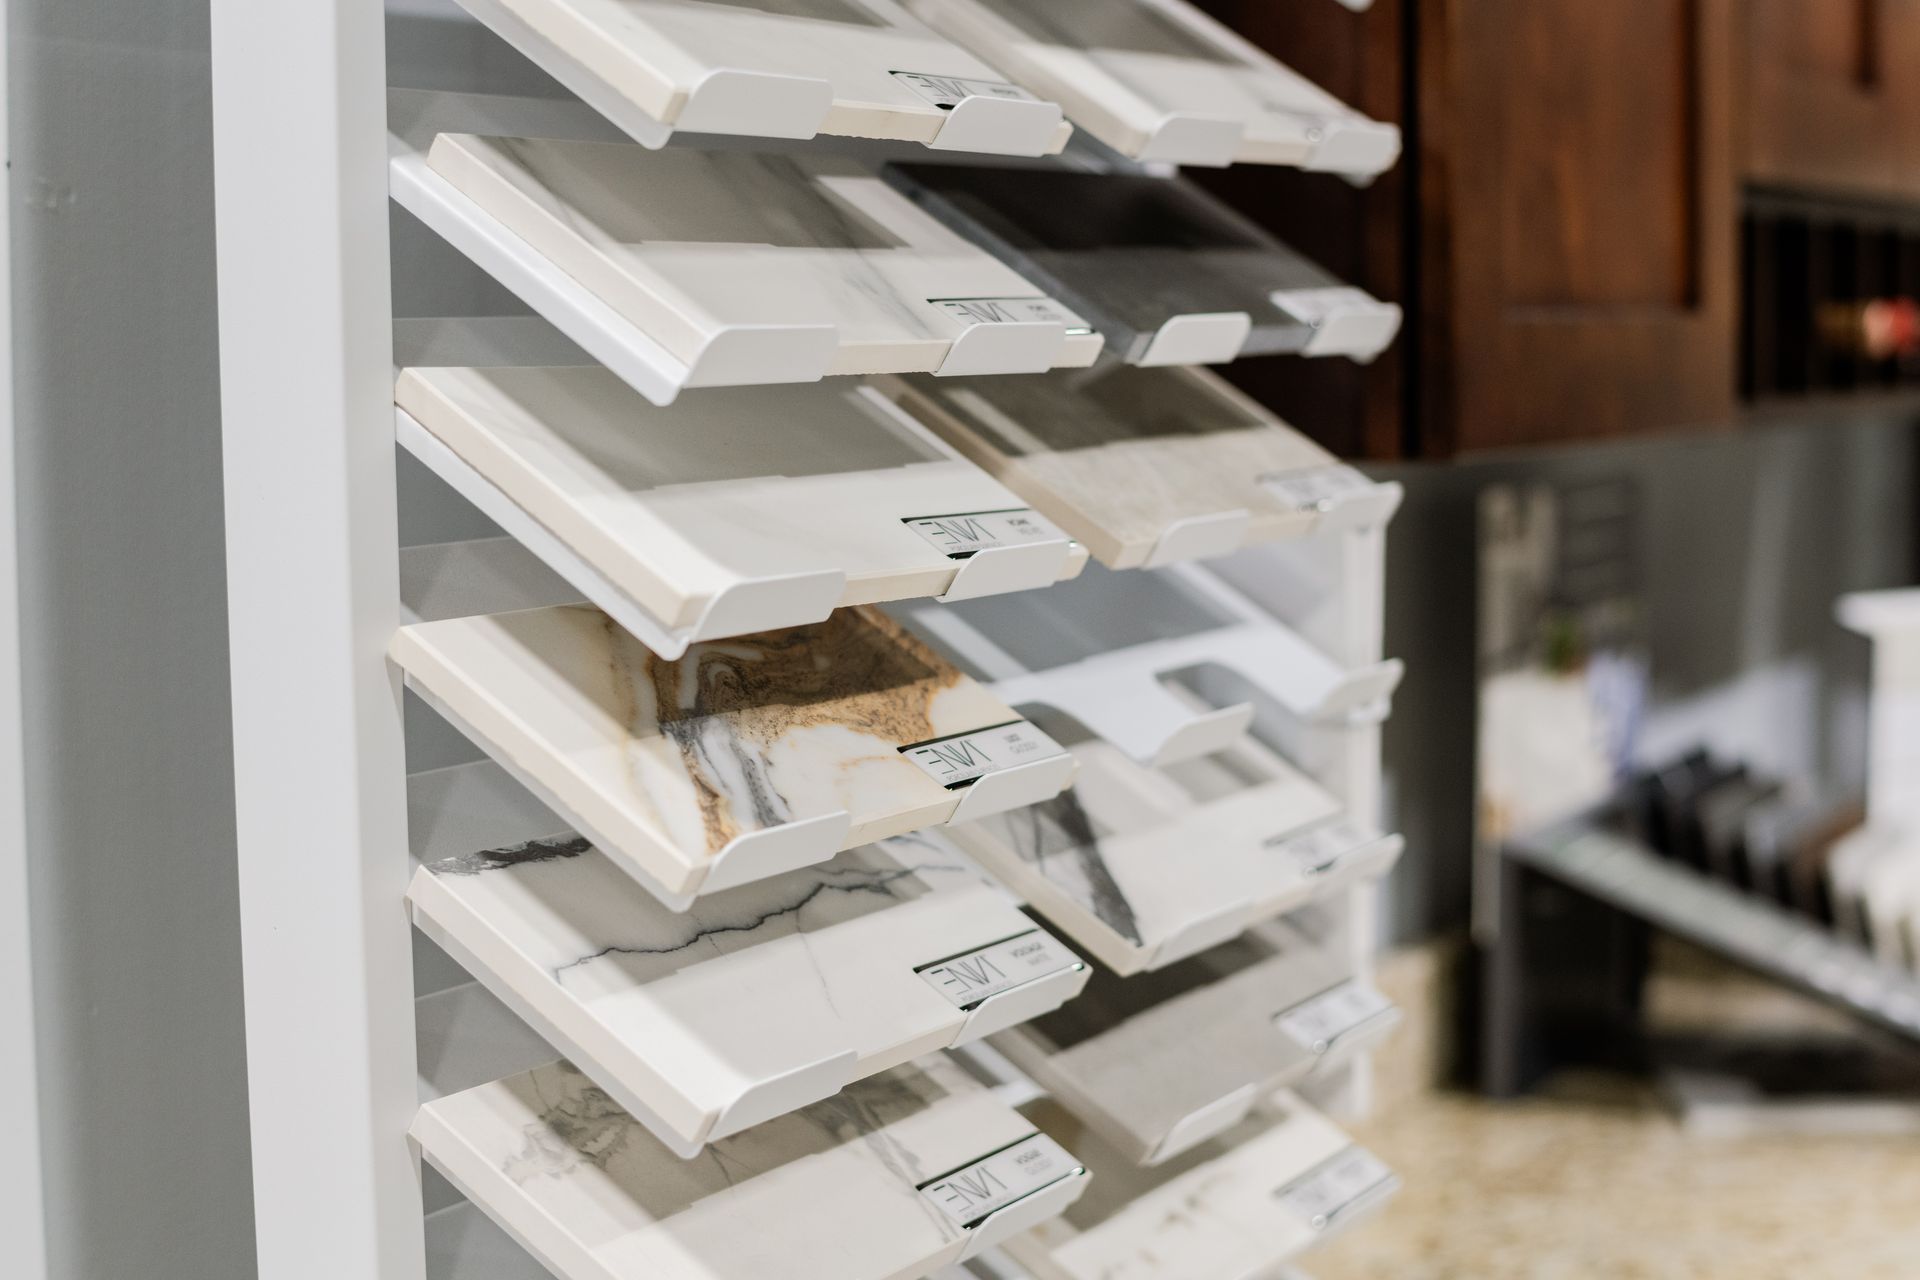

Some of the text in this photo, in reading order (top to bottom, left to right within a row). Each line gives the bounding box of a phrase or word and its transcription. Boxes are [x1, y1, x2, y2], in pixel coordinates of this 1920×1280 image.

[919, 518, 997, 545] ENVI
[915, 739, 992, 775] ENVI
[930, 954, 1007, 995] ENVI
[932, 1166, 1008, 1212] ENVI
